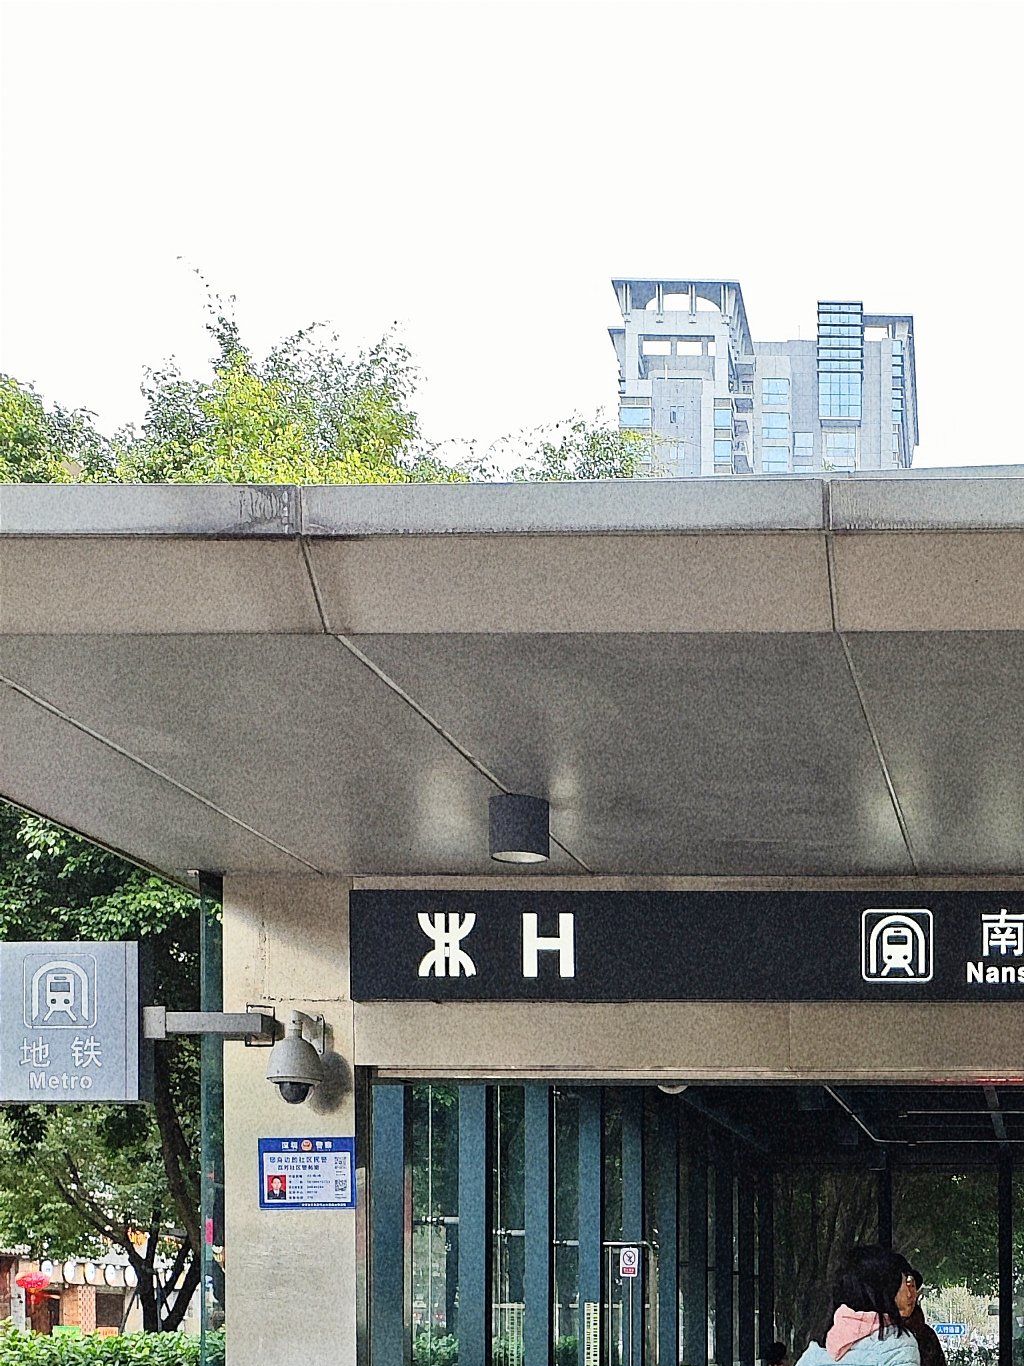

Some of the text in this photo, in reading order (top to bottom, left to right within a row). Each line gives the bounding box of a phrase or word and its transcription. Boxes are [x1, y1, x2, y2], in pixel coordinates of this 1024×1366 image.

[522, 912, 575, 978] H
[18, 1036, 103, 1068] 地铁
[28, 1071, 93, 1090] Metro
